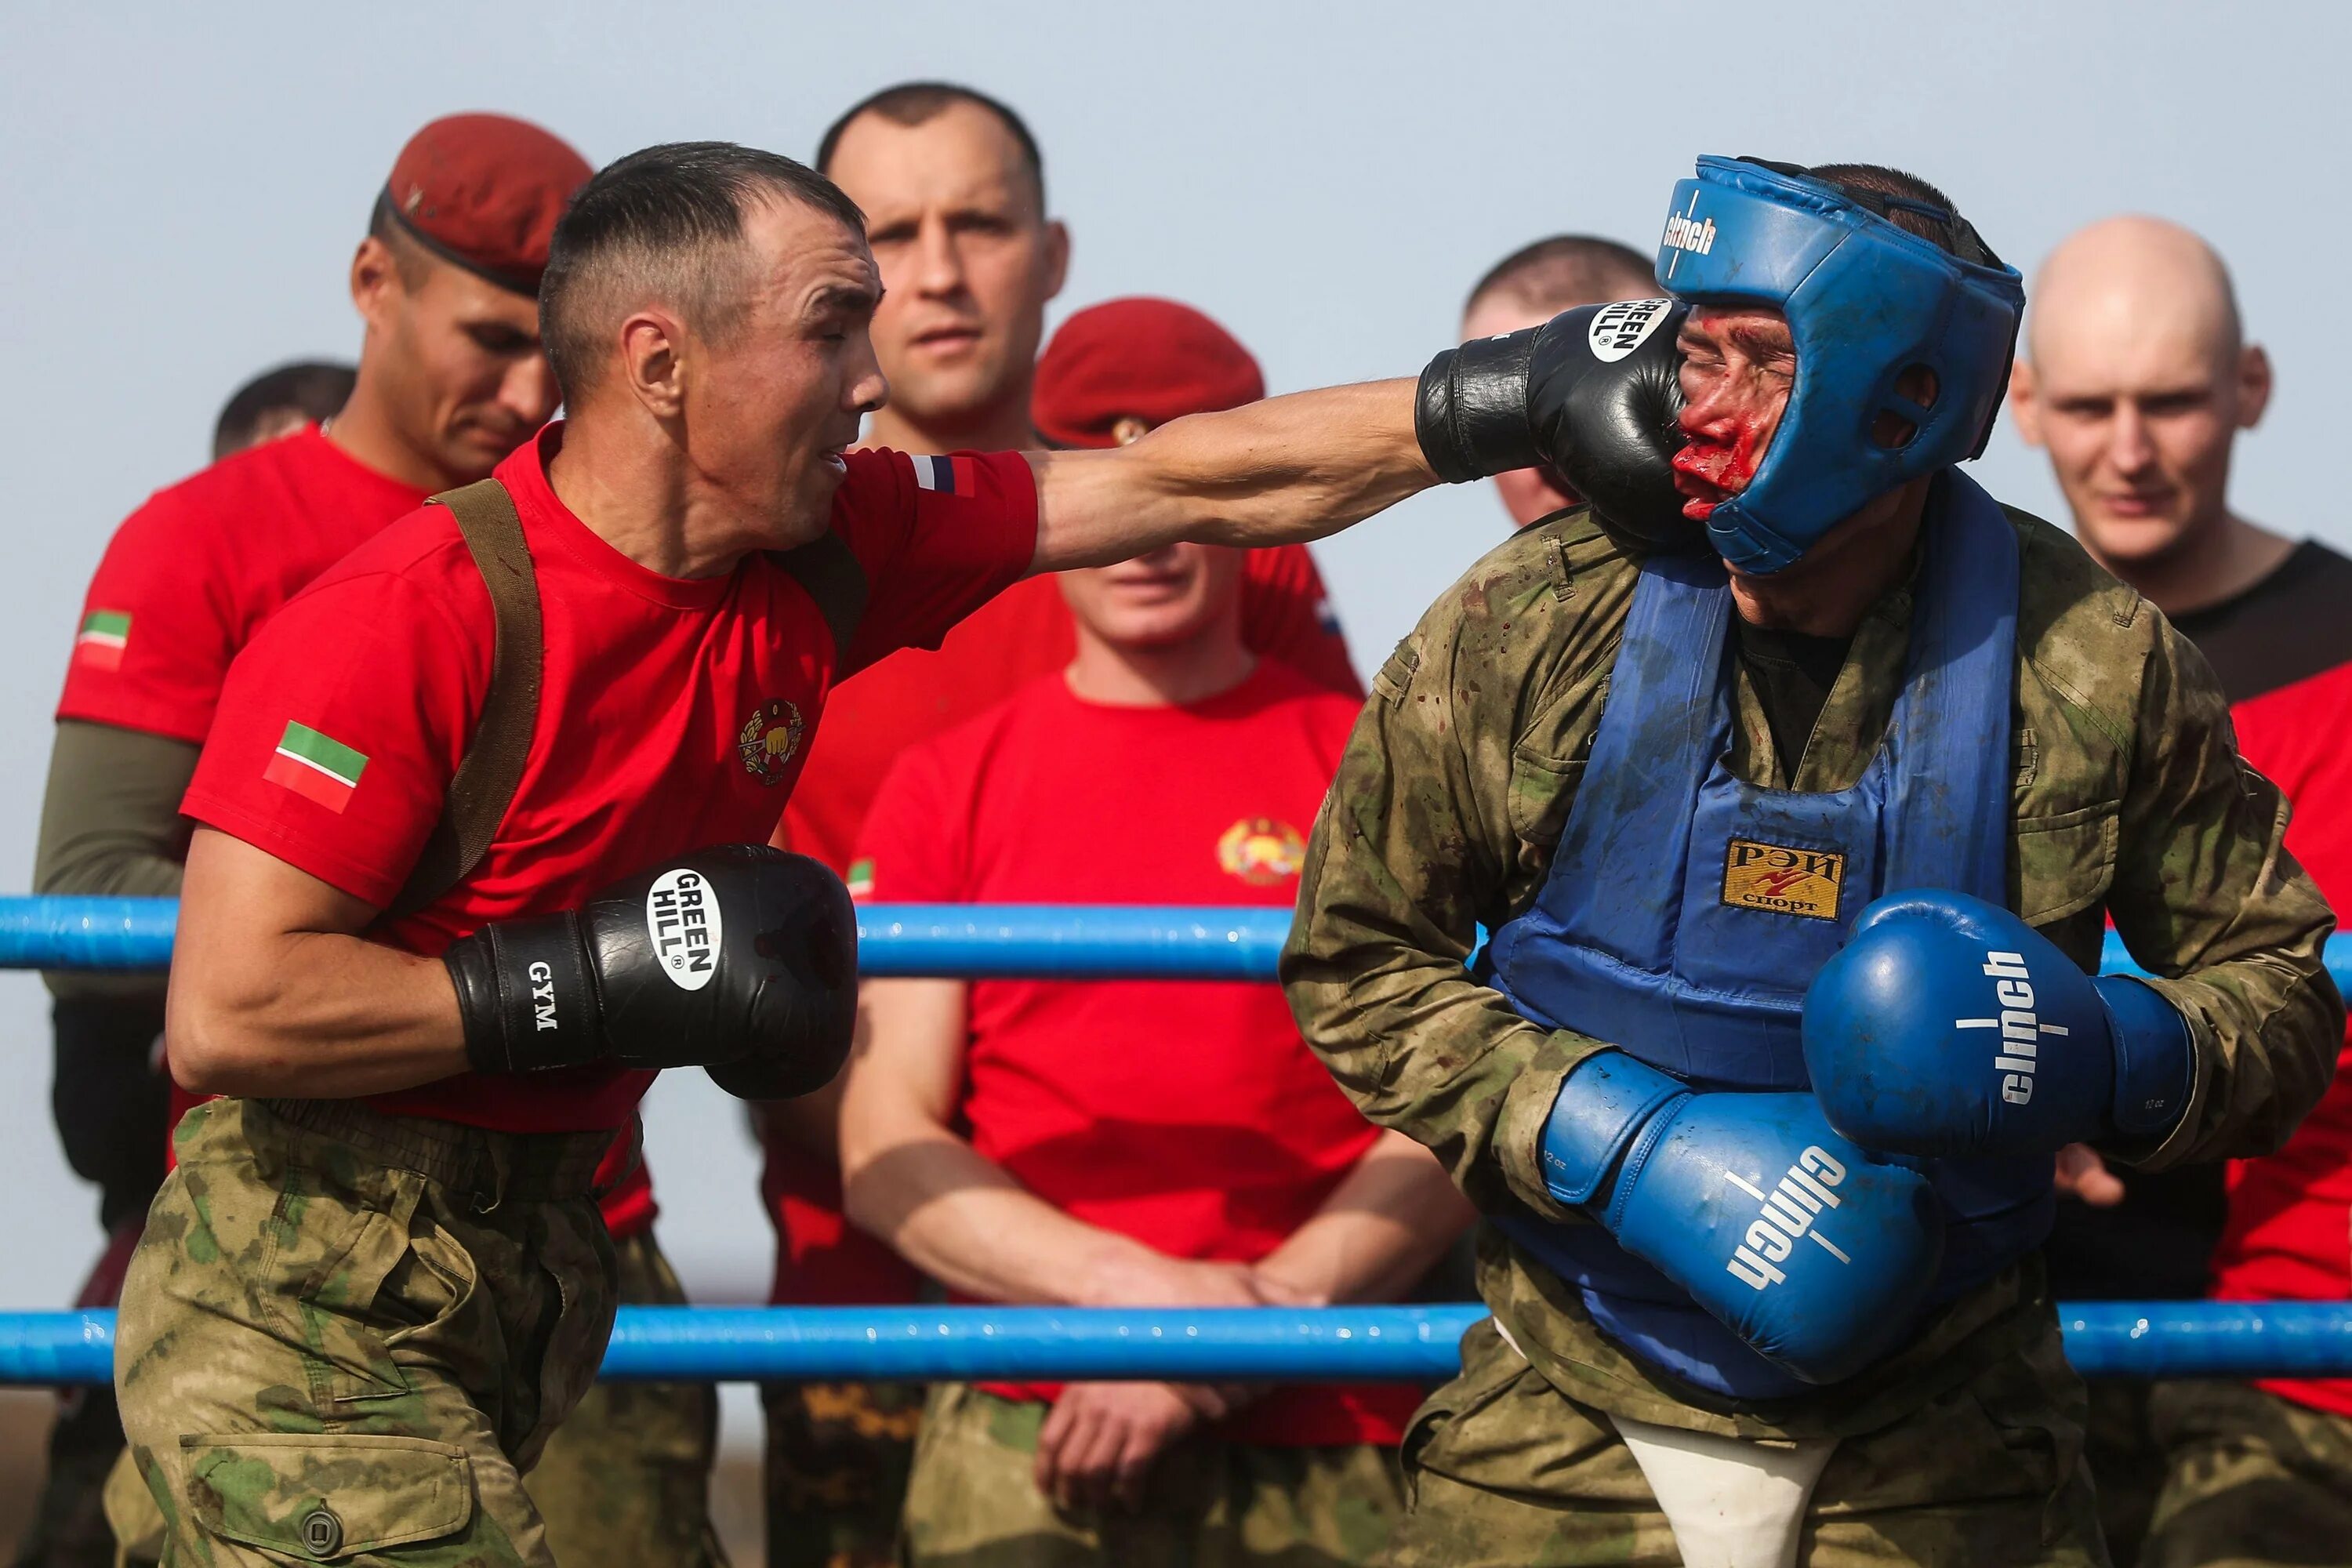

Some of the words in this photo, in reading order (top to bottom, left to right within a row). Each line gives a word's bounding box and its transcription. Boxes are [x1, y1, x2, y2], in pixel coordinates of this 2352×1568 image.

[1663, 210, 1716, 256] clinch
[1613, 299, 1668, 349] GREEN
[677, 873, 712, 972] GREEN
[1742, 894, 1818, 912] спорт
[528, 961, 557, 1032] GYM
[1982, 951, 2038, 1105] clinch
[1726, 1145, 1847, 1290] clinch
